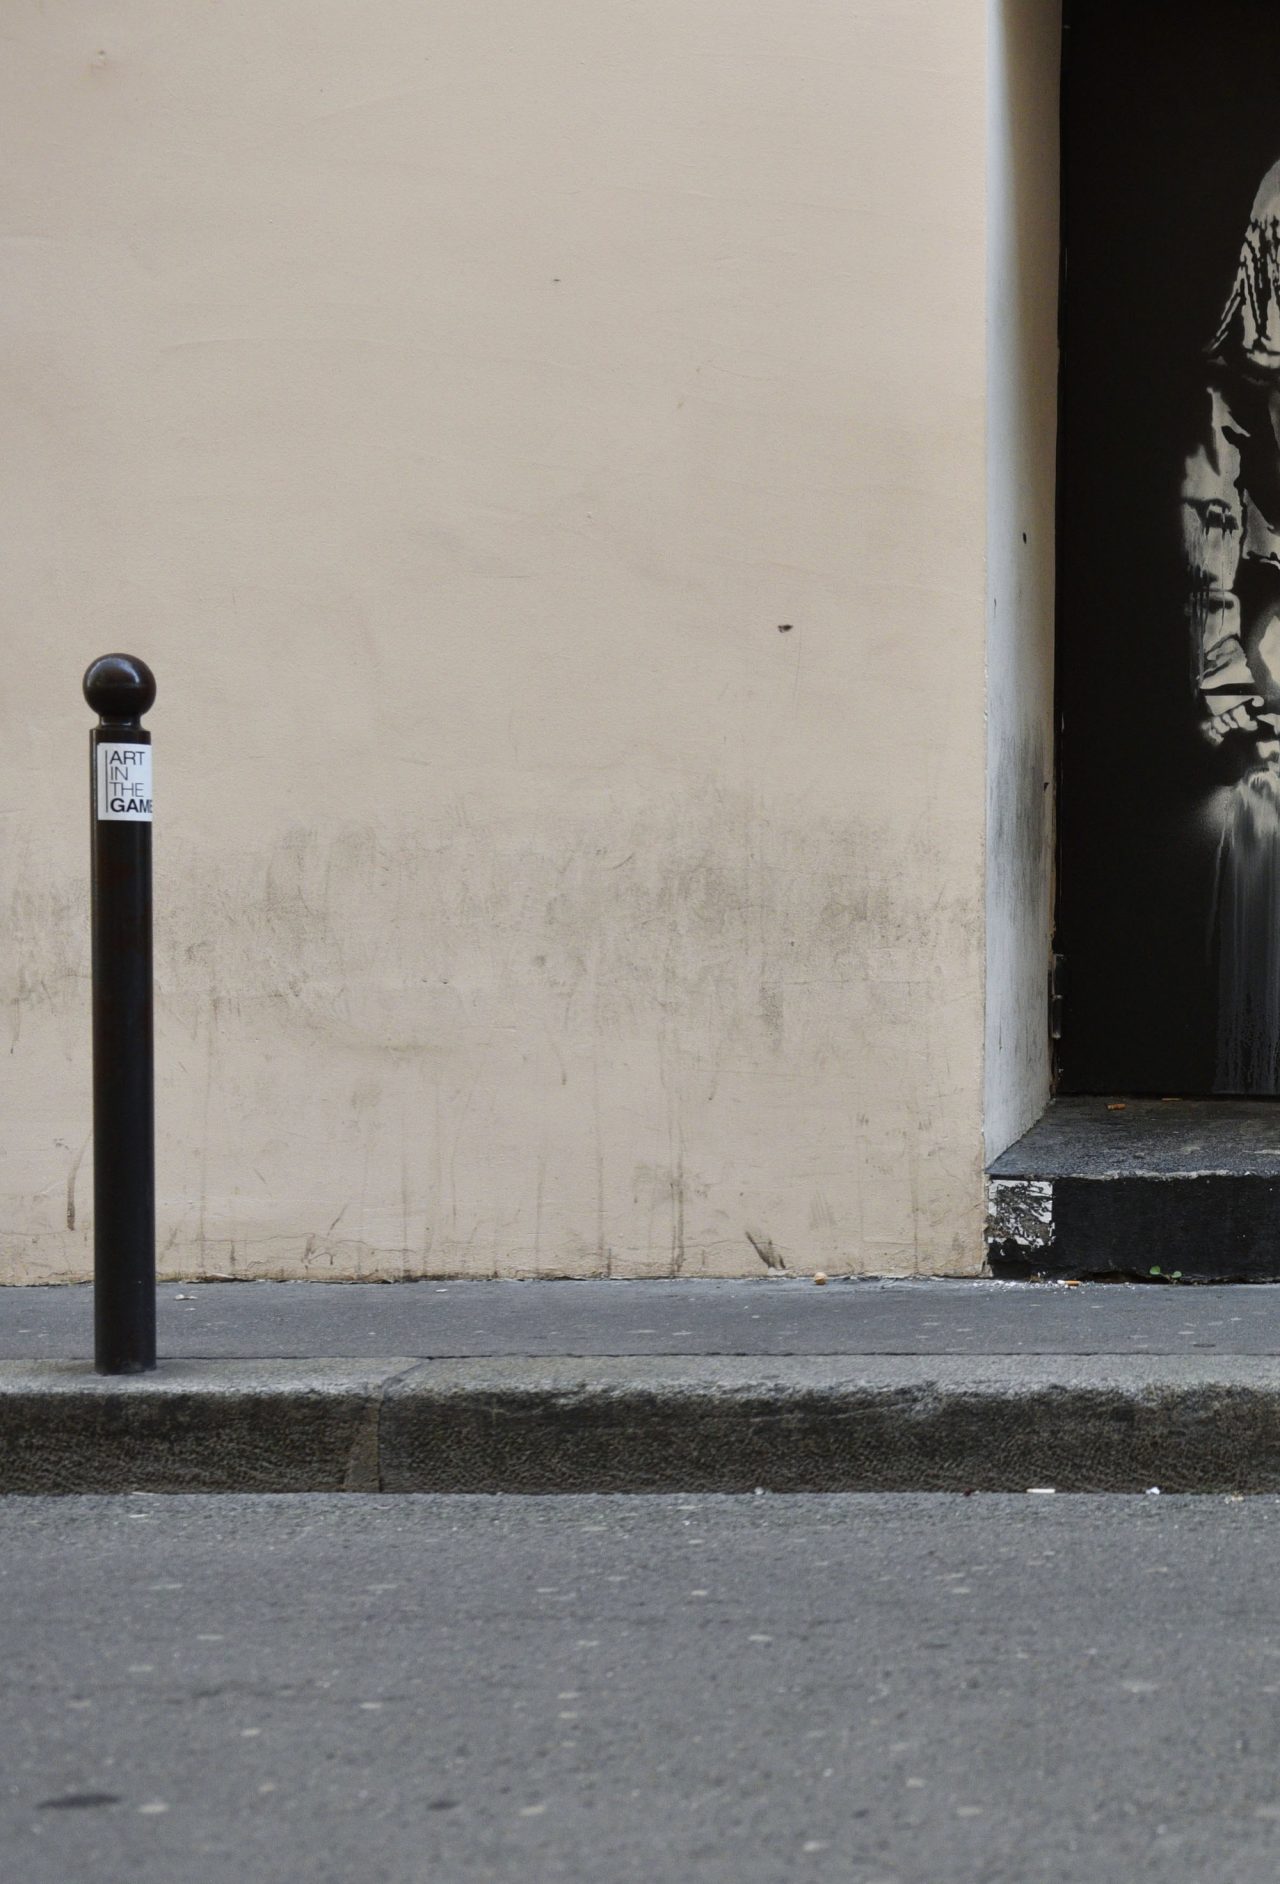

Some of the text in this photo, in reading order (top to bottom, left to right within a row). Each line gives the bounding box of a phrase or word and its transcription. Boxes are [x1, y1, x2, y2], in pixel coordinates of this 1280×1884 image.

[109, 750, 145, 765] ART
[110, 766, 128, 780] IN
[109, 781, 144, 797] THE
